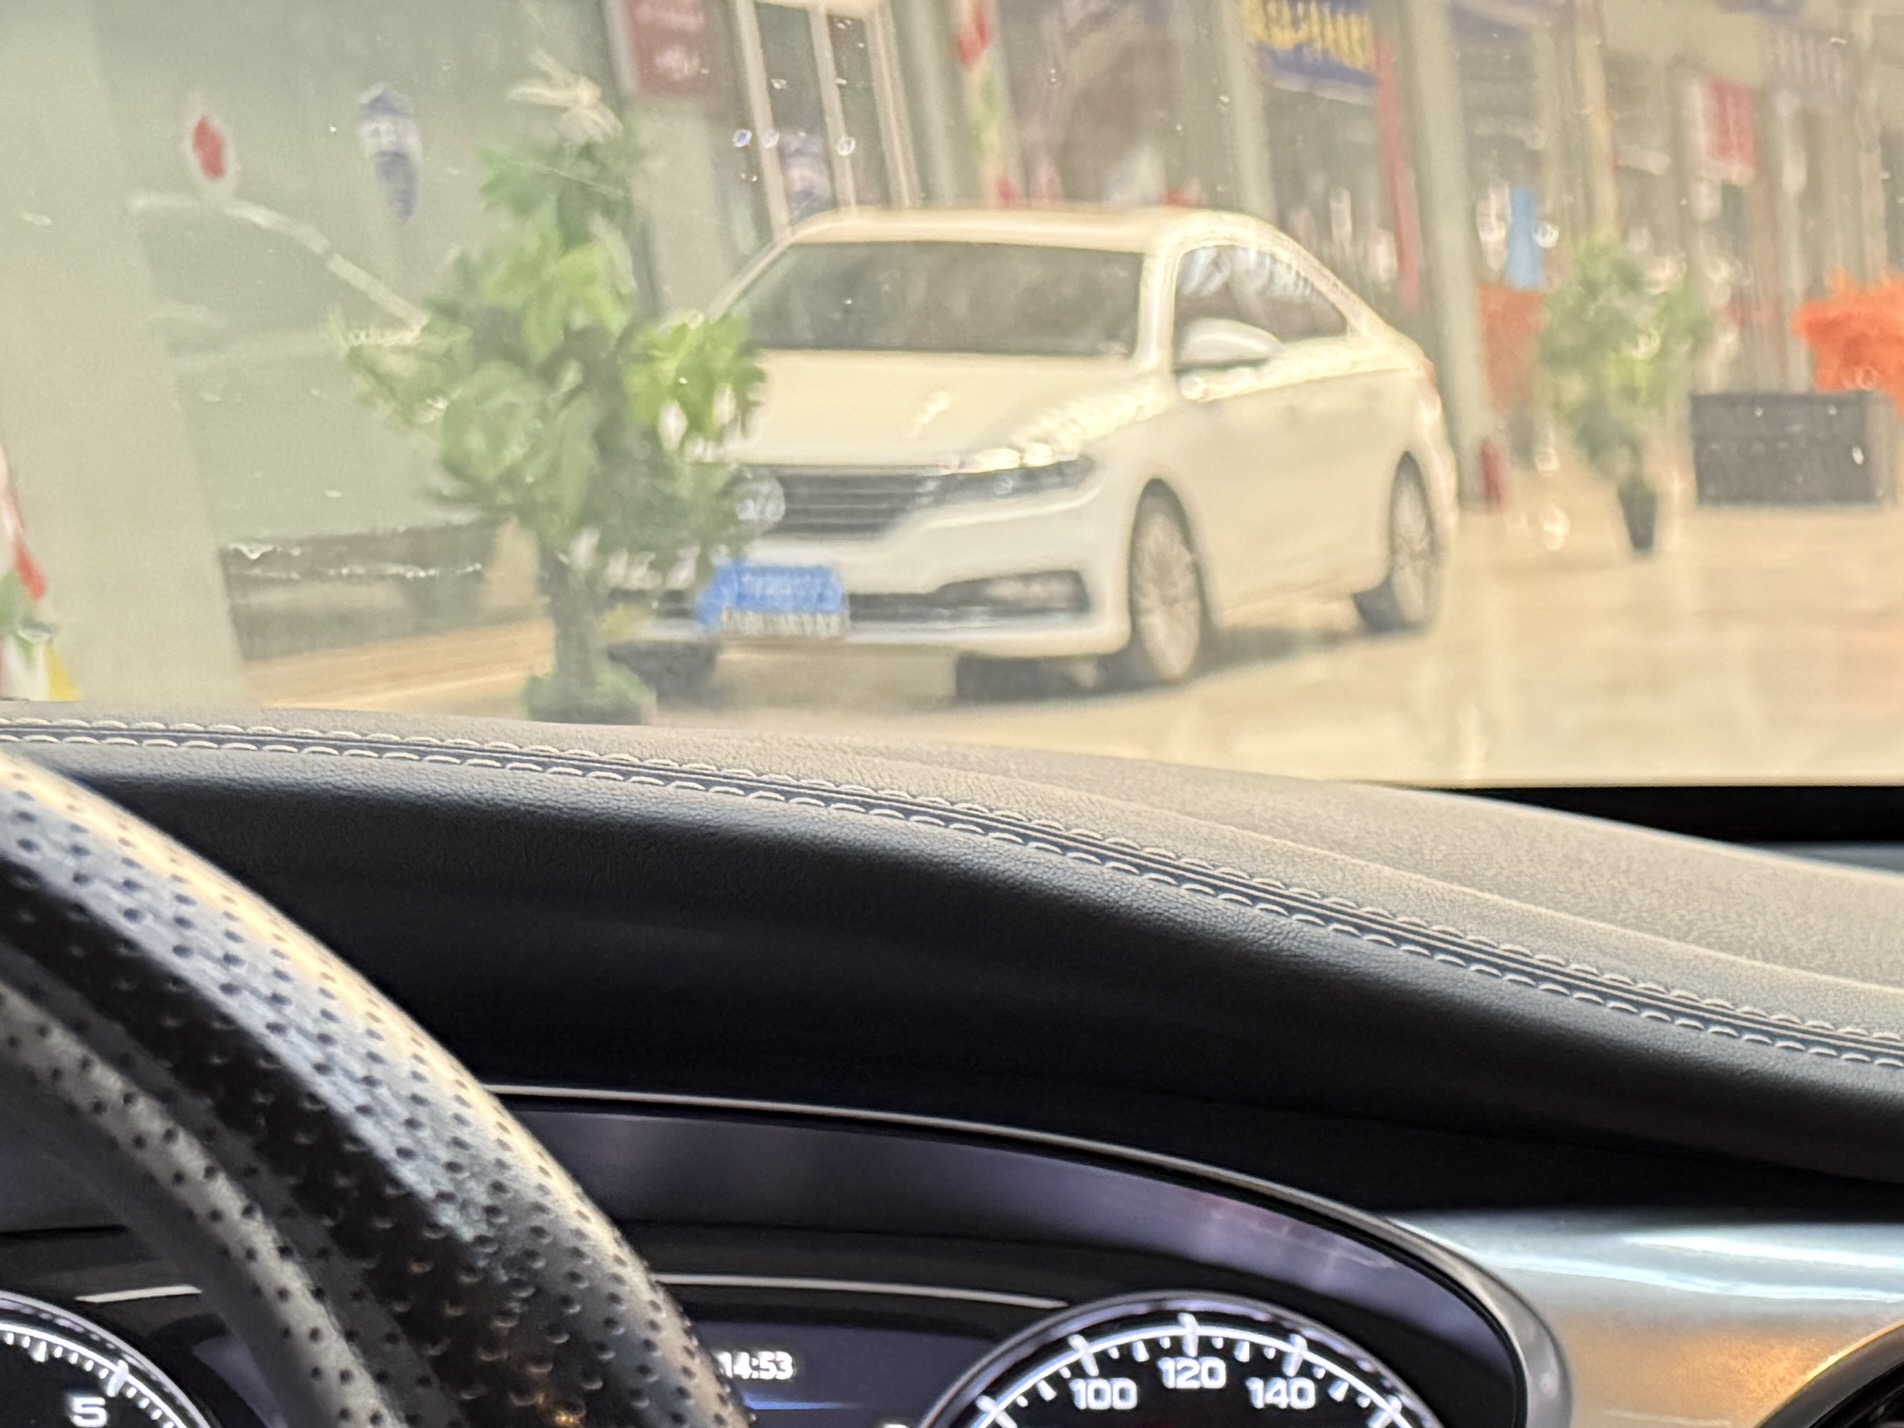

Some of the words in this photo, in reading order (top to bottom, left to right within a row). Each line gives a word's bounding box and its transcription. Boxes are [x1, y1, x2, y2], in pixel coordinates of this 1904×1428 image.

[717, 1350, 794, 1380] 14:53
[1158, 1356, 1227, 1390] 120
[1070, 1376, 1138, 1411] 100
[1246, 1376, 1316, 1410] 140
[71, 1397, 108, 1427] 5
